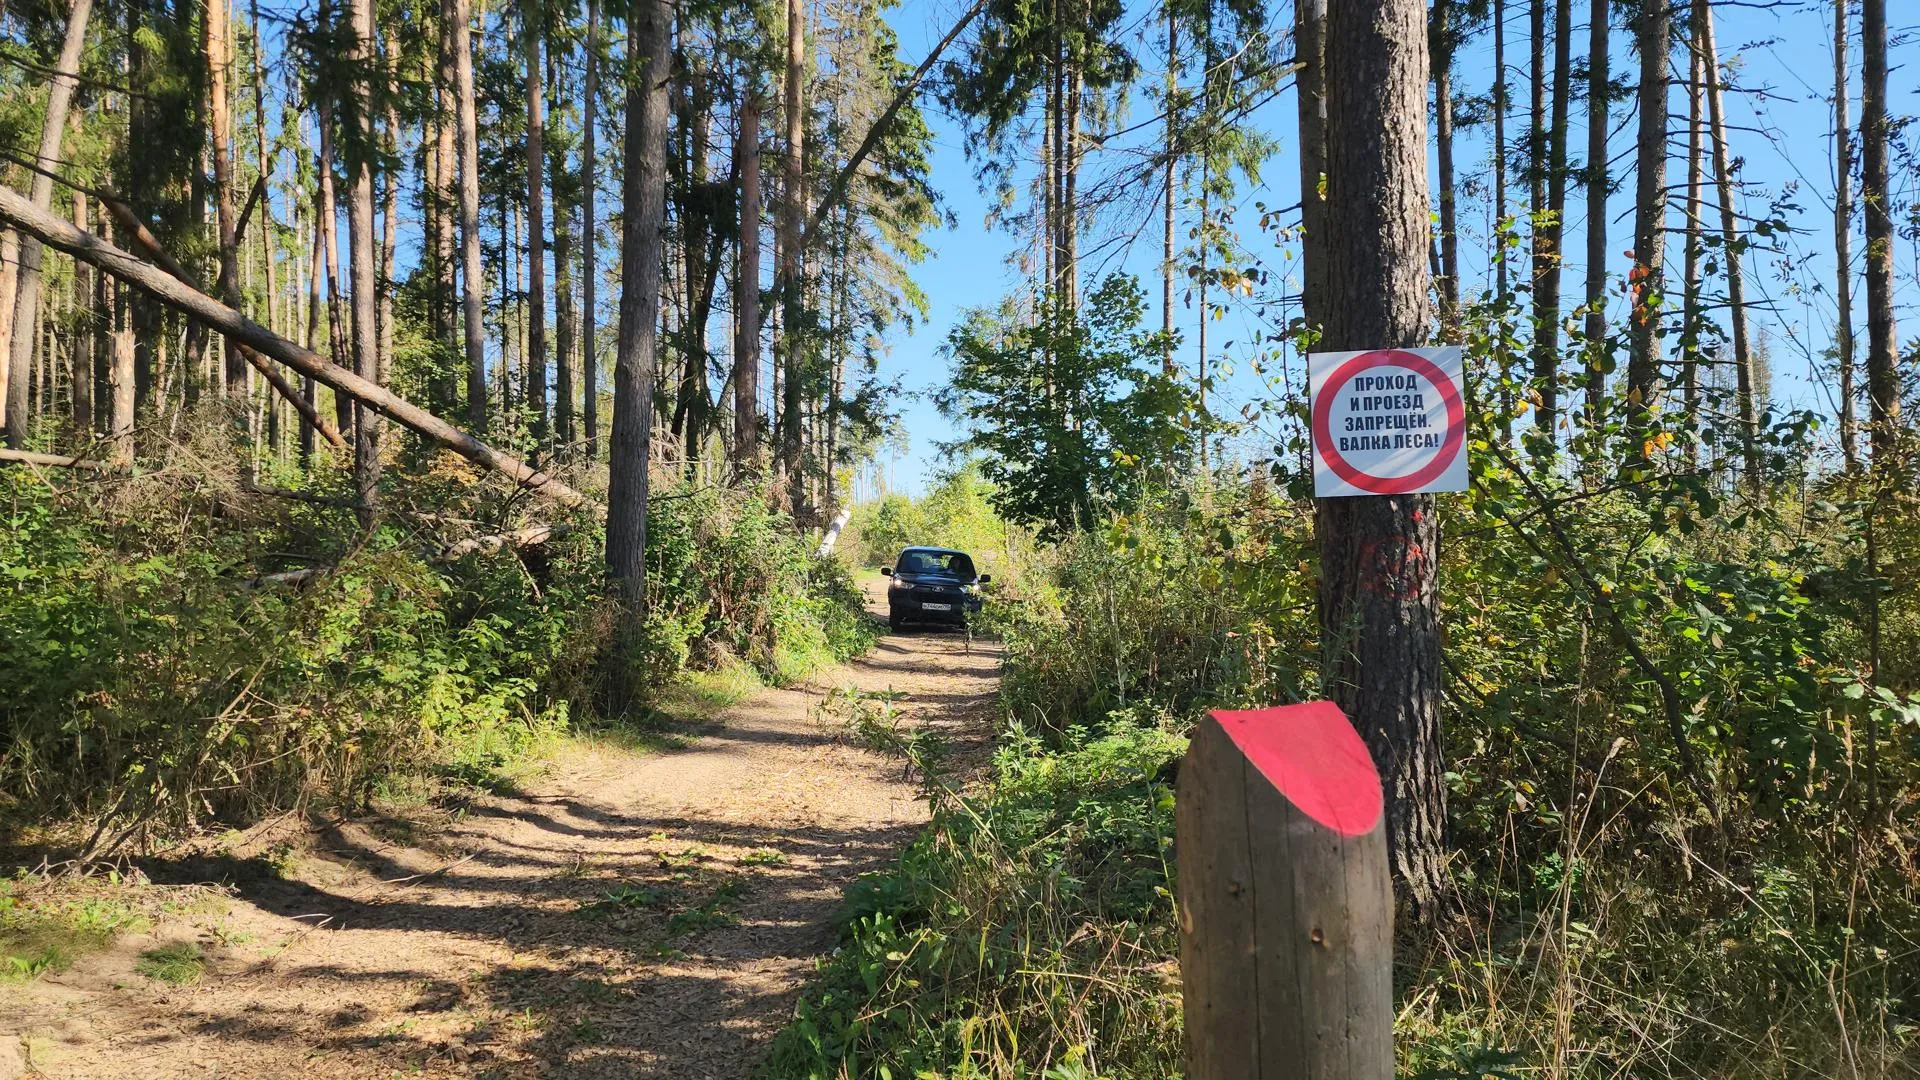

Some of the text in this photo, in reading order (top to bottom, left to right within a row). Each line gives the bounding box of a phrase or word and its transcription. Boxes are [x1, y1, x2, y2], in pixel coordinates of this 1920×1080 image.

[1355, 375, 1417, 391] ПРОХОД
[1350, 394, 1424, 411] И ПРОЕЗД
[1345, 412, 1431, 431] ЗАПРЕЩЁН.
[1340, 433, 1439, 451] ВАЛКА ЛЕСА!
